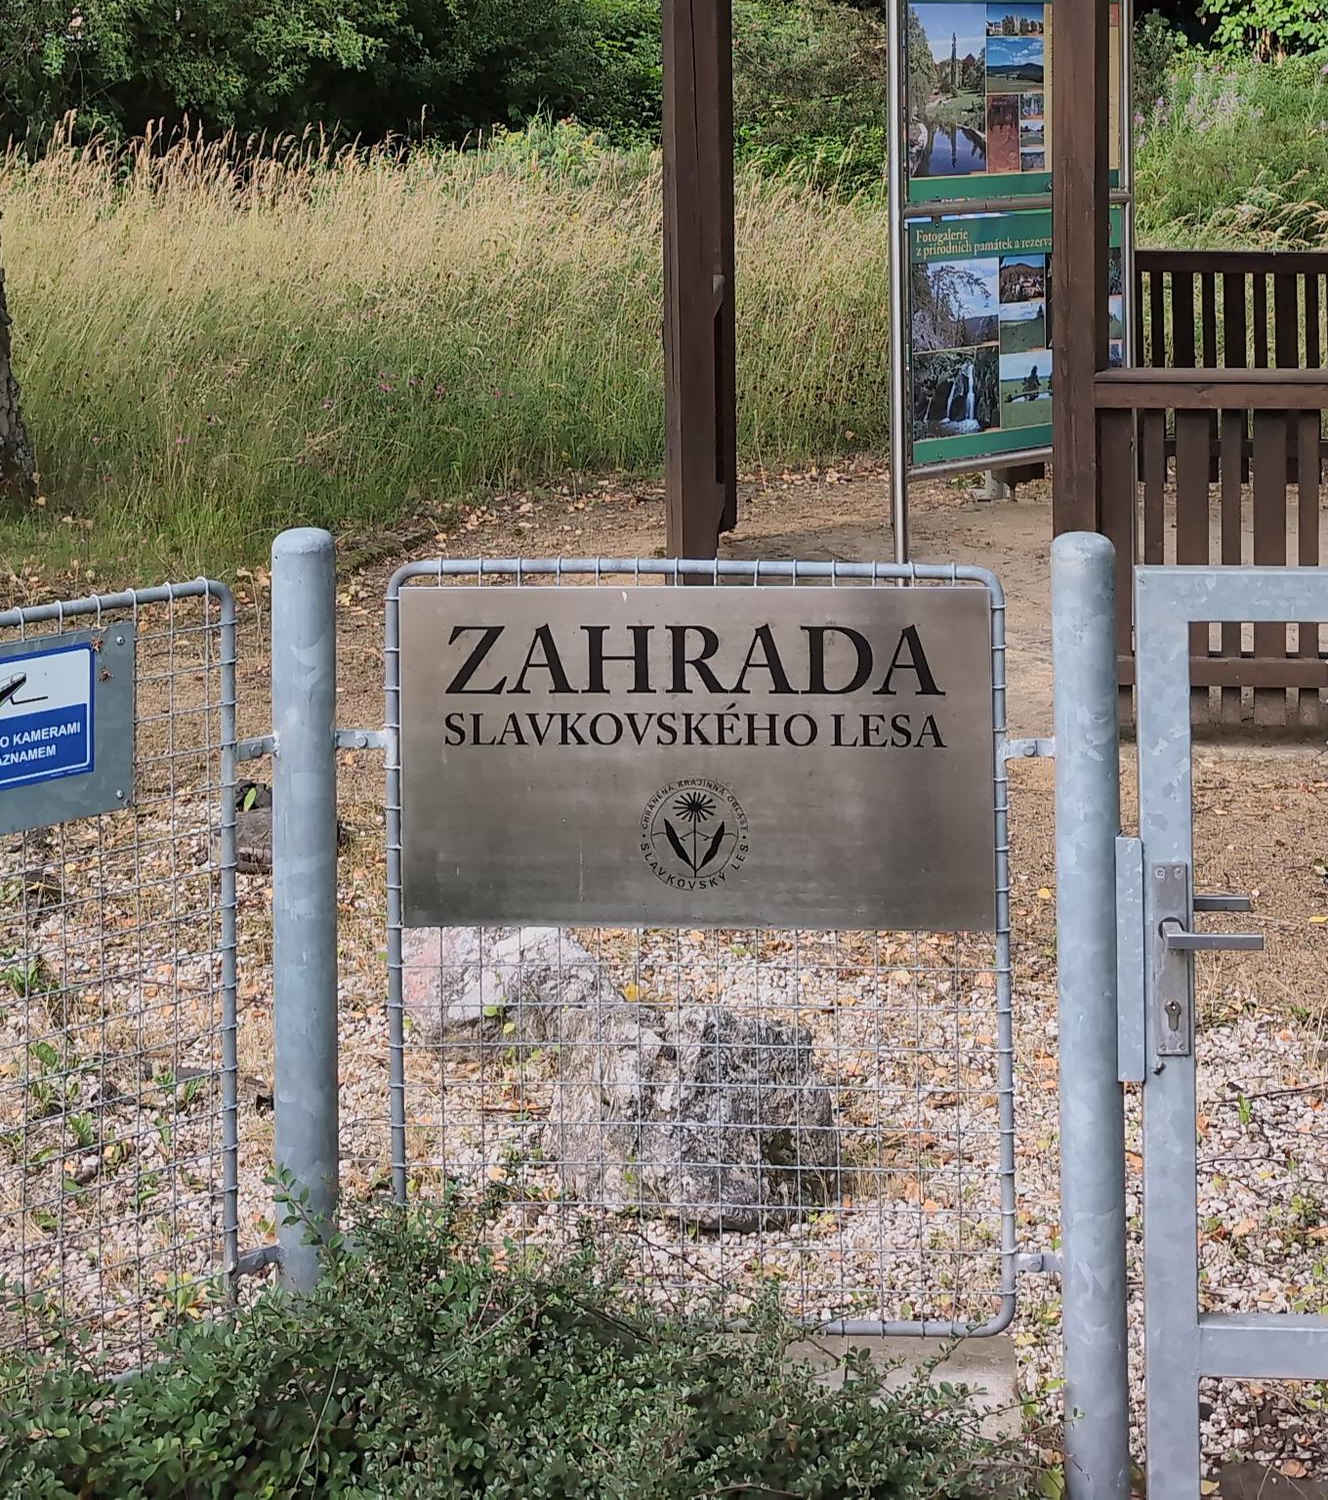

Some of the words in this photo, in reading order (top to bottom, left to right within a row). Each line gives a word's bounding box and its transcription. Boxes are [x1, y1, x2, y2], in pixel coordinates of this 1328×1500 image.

[916, 228, 968, 246] Fotogalerie
[916, 247, 922, 256] z
[923, 240, 972, 260] přírodních
[974, 236, 1013, 256] památek
[1014, 240, 1020, 248] a
[445, 623, 946, 696] ZAHRADA
[13, 721, 81, 746] KAMERAMI
[444, 703, 818, 747] SLAVKOVSKÉHO
[830, 713, 948, 748] LESA
[731, 843, 749, 871] LES
